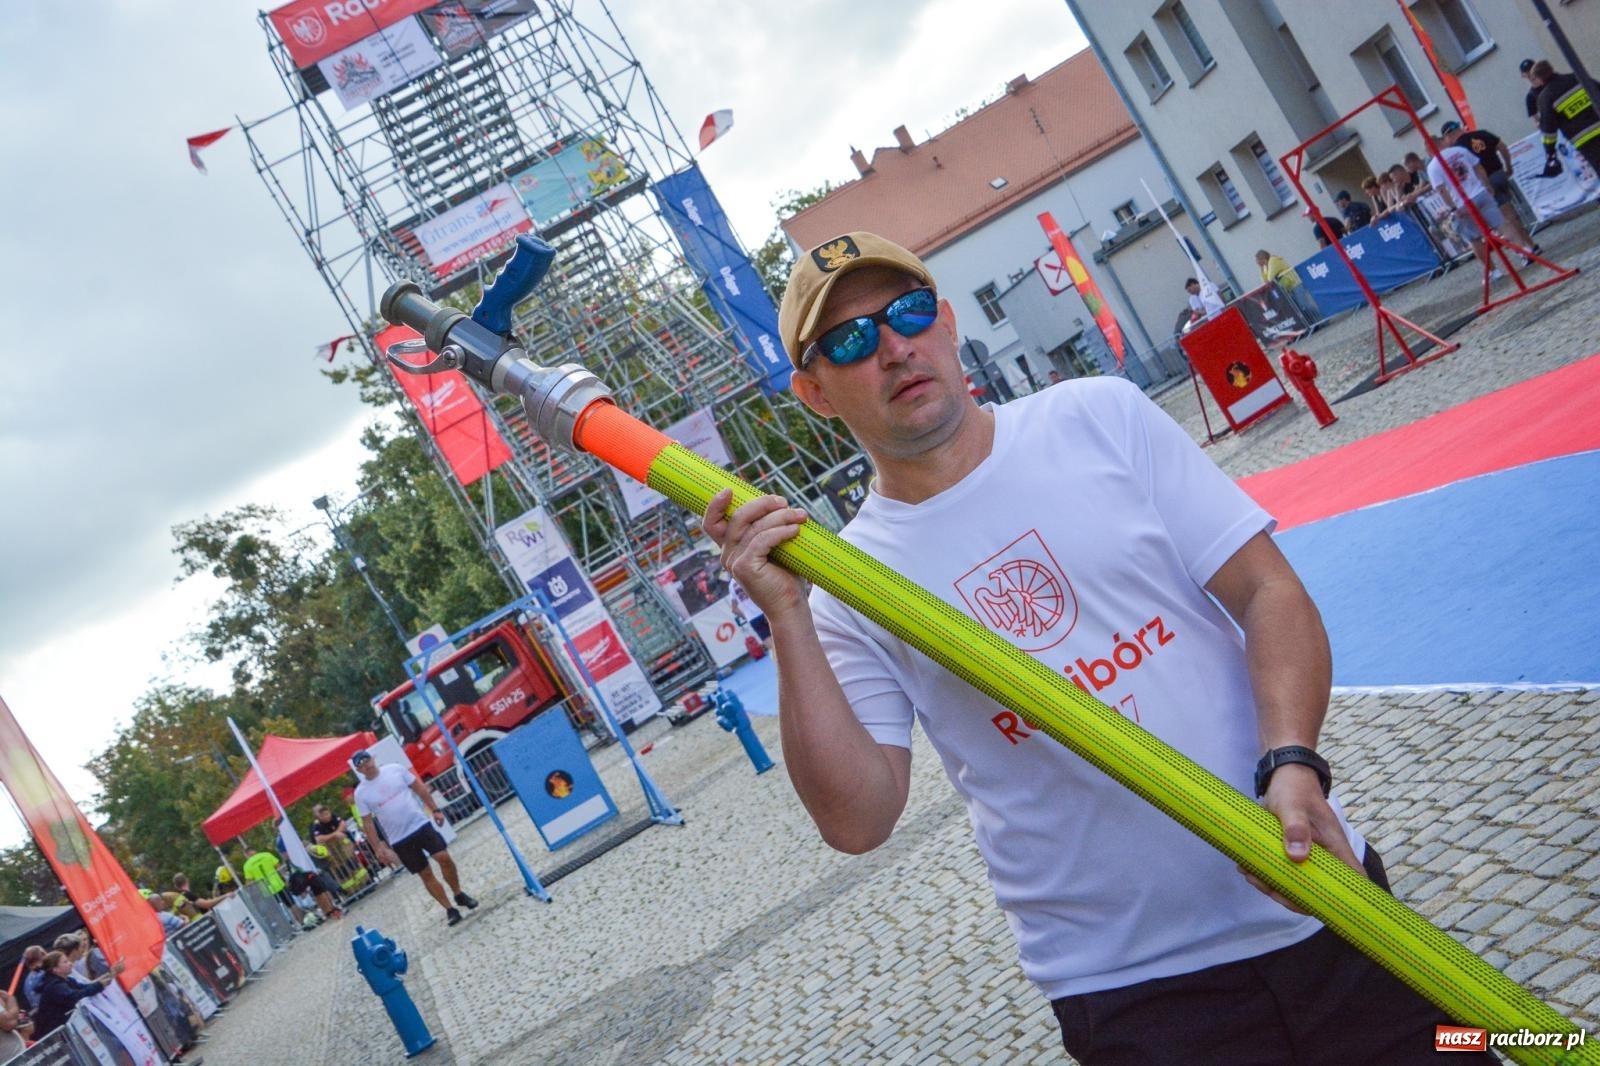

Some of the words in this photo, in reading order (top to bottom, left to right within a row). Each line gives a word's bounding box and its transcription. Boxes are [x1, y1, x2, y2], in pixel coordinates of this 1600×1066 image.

[323, 0, 389, 26] Rac
[1568, 94, 1591, 115] STRA
[991, 615, 1176, 746] Ribórz
